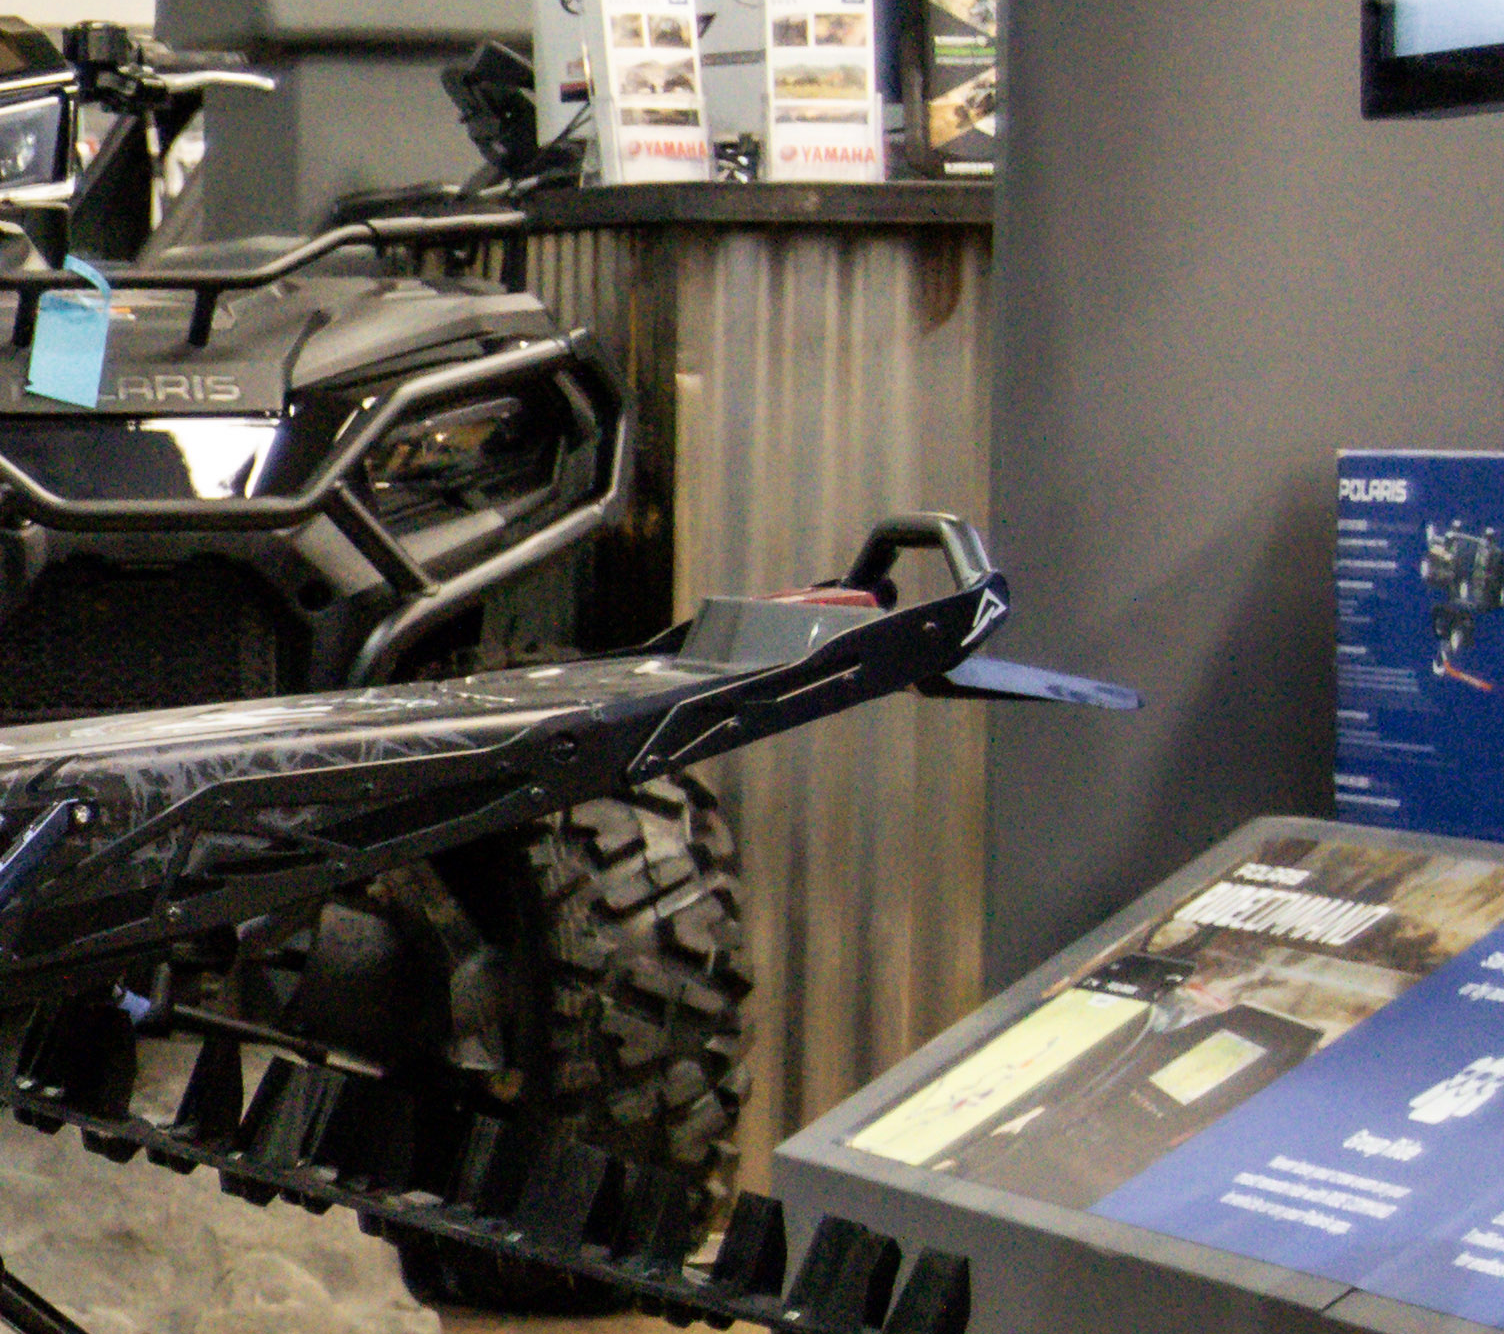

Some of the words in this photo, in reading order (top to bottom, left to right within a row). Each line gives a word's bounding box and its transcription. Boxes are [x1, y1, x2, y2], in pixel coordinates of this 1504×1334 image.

[644, 140, 709, 160] YAMAHA
[801, 146, 877, 164] YAMAHA
[1337, 477, 1408, 504] POLARIS
